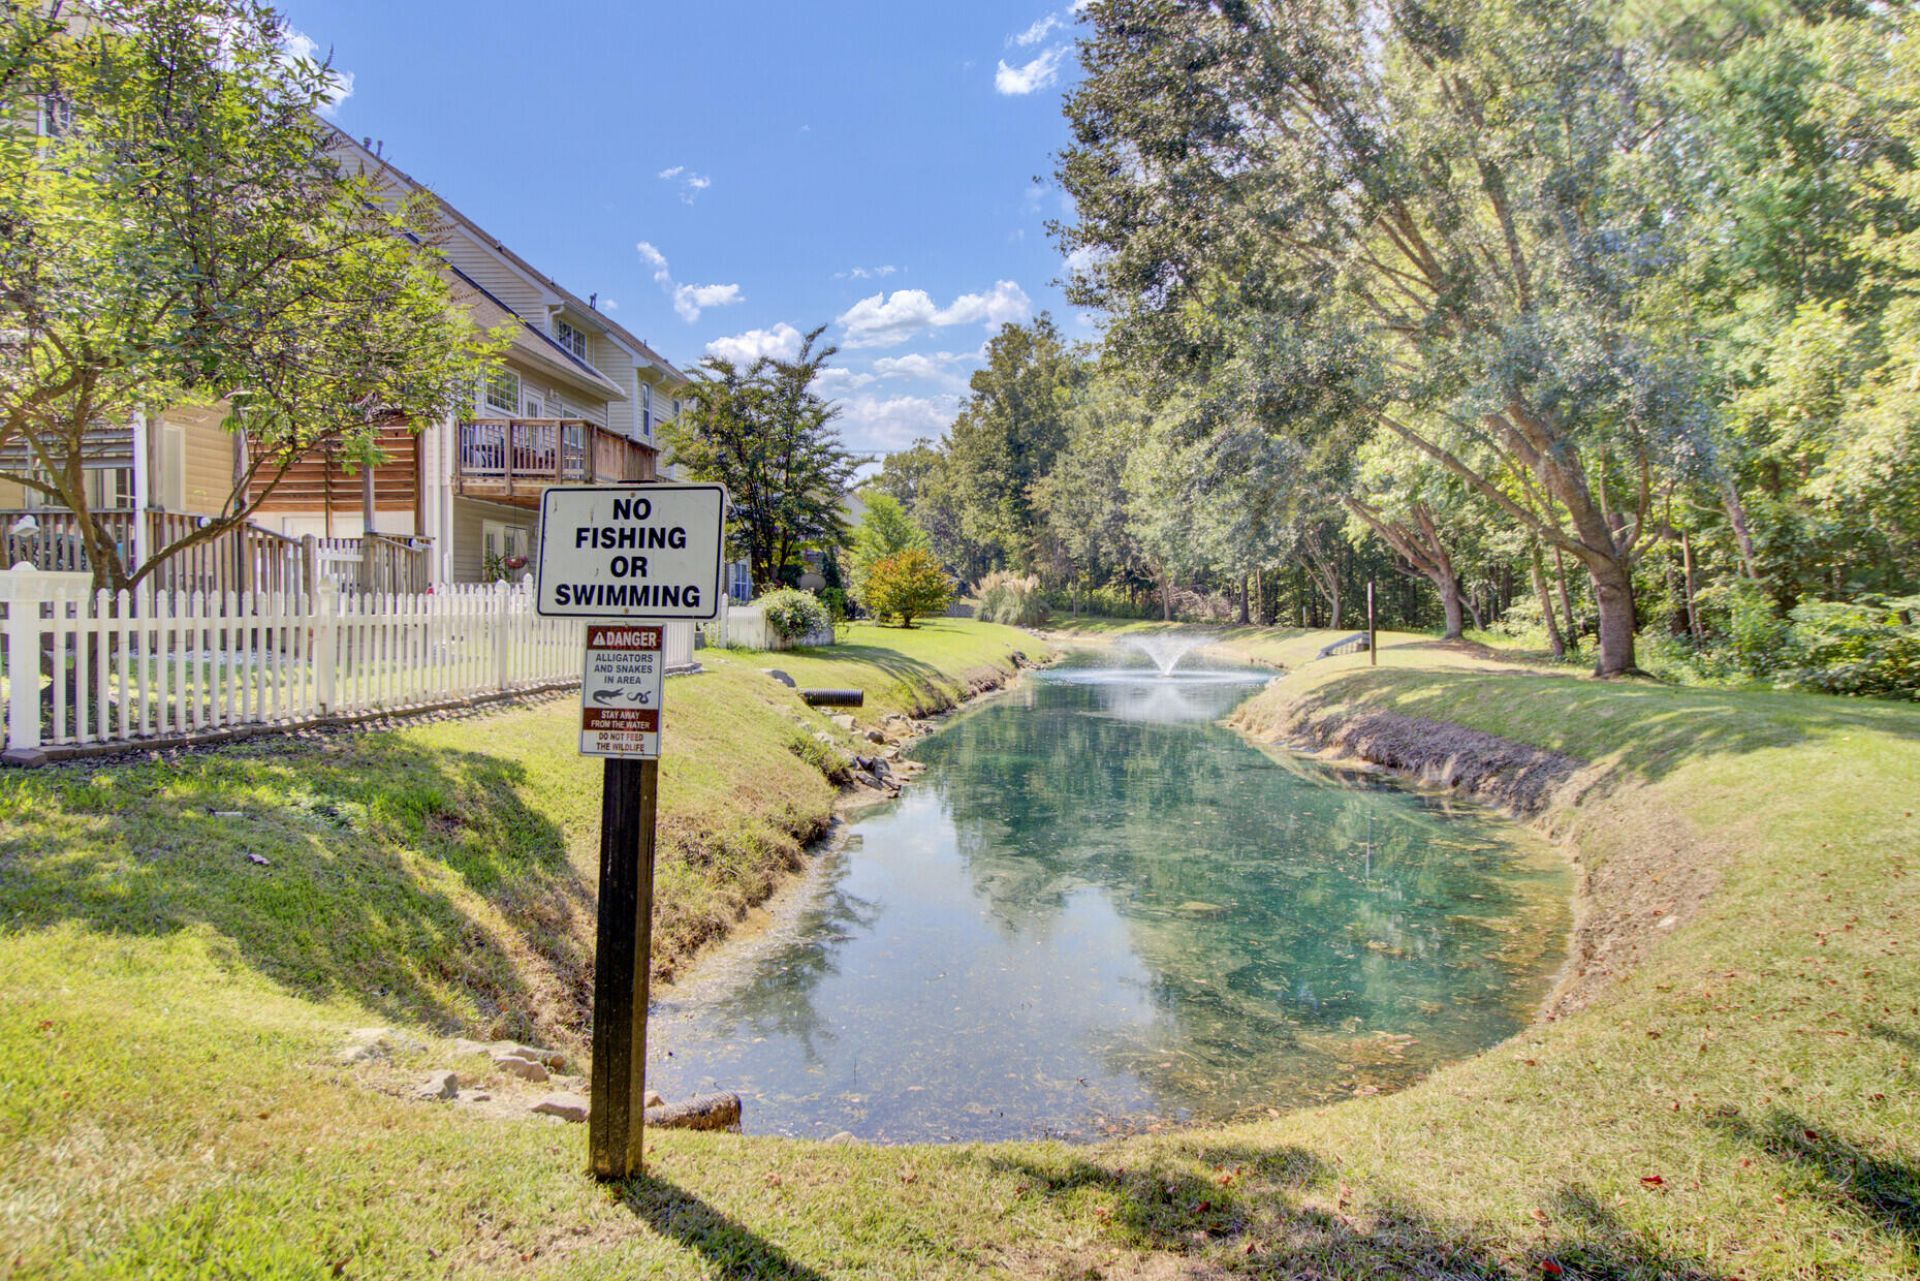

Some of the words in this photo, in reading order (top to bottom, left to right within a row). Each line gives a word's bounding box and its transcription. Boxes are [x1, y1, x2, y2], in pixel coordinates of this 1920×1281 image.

[613, 498, 652, 521] NO
[576, 526, 687, 549] FISHING
[610, 556, 648, 578] OR
[555, 584, 700, 608] SWIMMING
[606, 631, 657, 647] DANGER
[595, 653, 653, 663] ALLIGATORS
[594, 664, 613, 673] AND
[616, 665, 653, 674] SNAKES
[604, 676, 614, 684] IN
[616, 676, 642, 684] AREA
[601, 710, 619, 719] STAY
[620, 711, 640, 720] AWAY
[591, 720, 611, 728] FROM
[612, 720, 625, 729] THE
[626, 721, 650, 729] WATER
[598, 732, 608, 740] DO
[610, 732, 624, 741] NOT
[626, 733, 644, 741] FEED
[596, 742, 610, 750] THE
[612, 743, 645, 752] WILDLIFE
